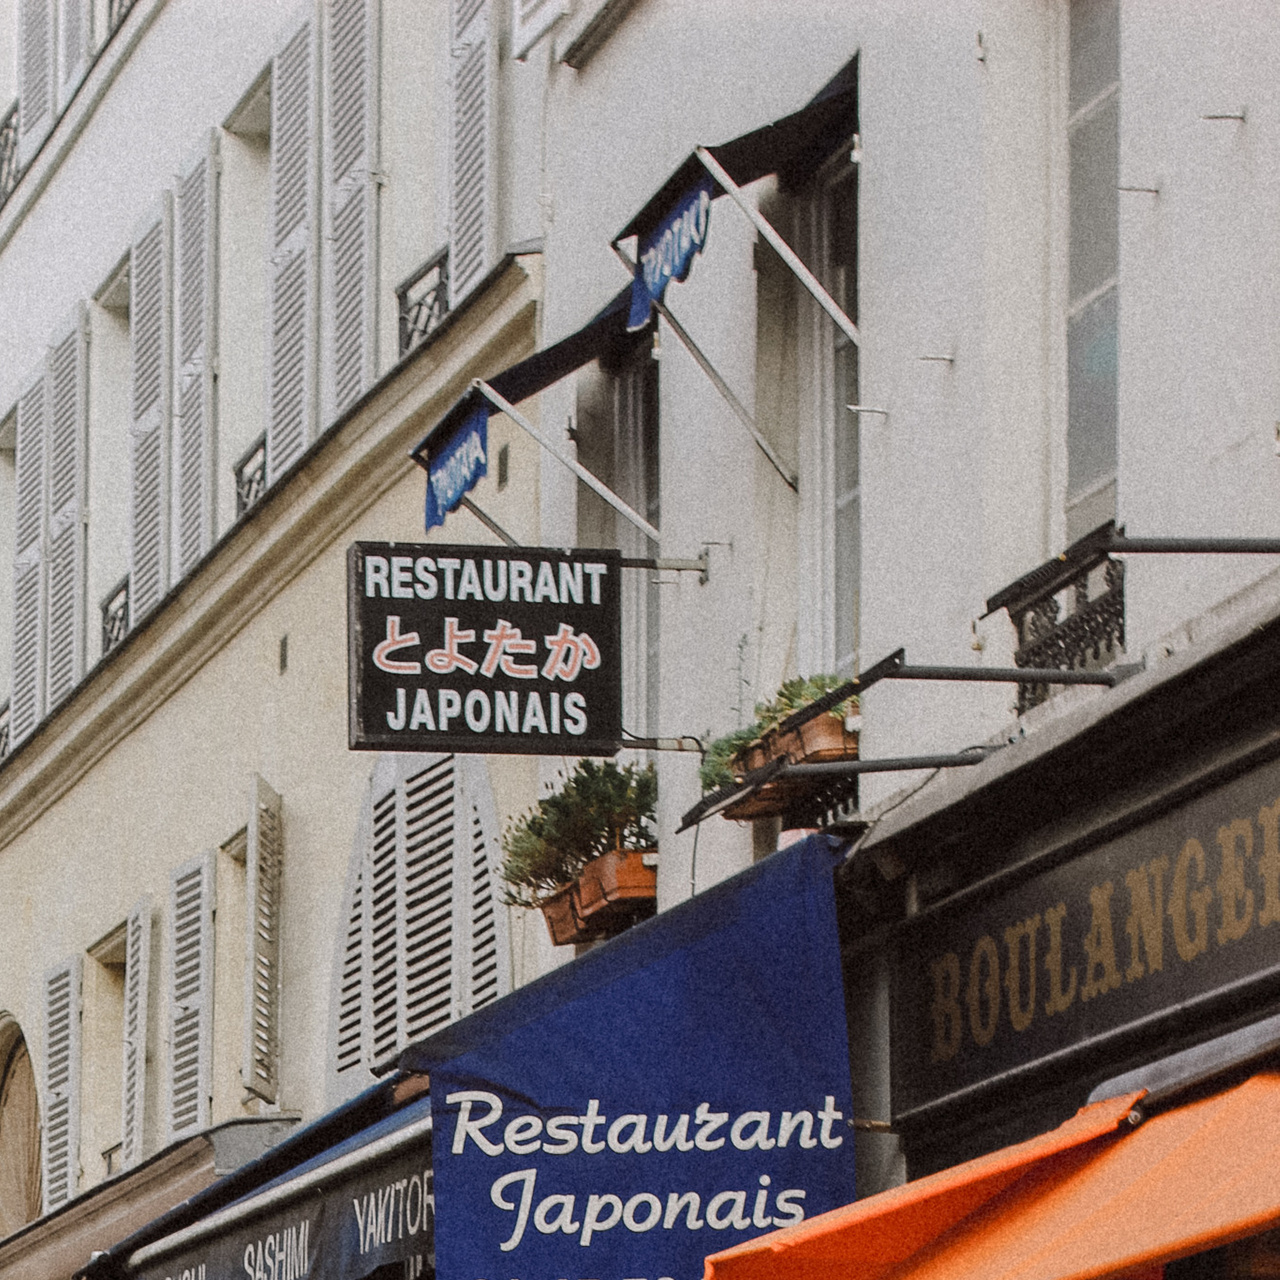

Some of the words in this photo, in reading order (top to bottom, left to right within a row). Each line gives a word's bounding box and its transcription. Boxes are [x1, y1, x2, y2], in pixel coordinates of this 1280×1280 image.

[365, 556, 607, 604] RESTAURANT
[372, 615, 601, 681] とよたか
[386, 688, 588, 735] JAPONAIS
[445, 1091, 844, 1157] Restaurant
[353, 1169, 435, 1255] YAKITOR
[489, 1168, 807, 1252] Japonais
